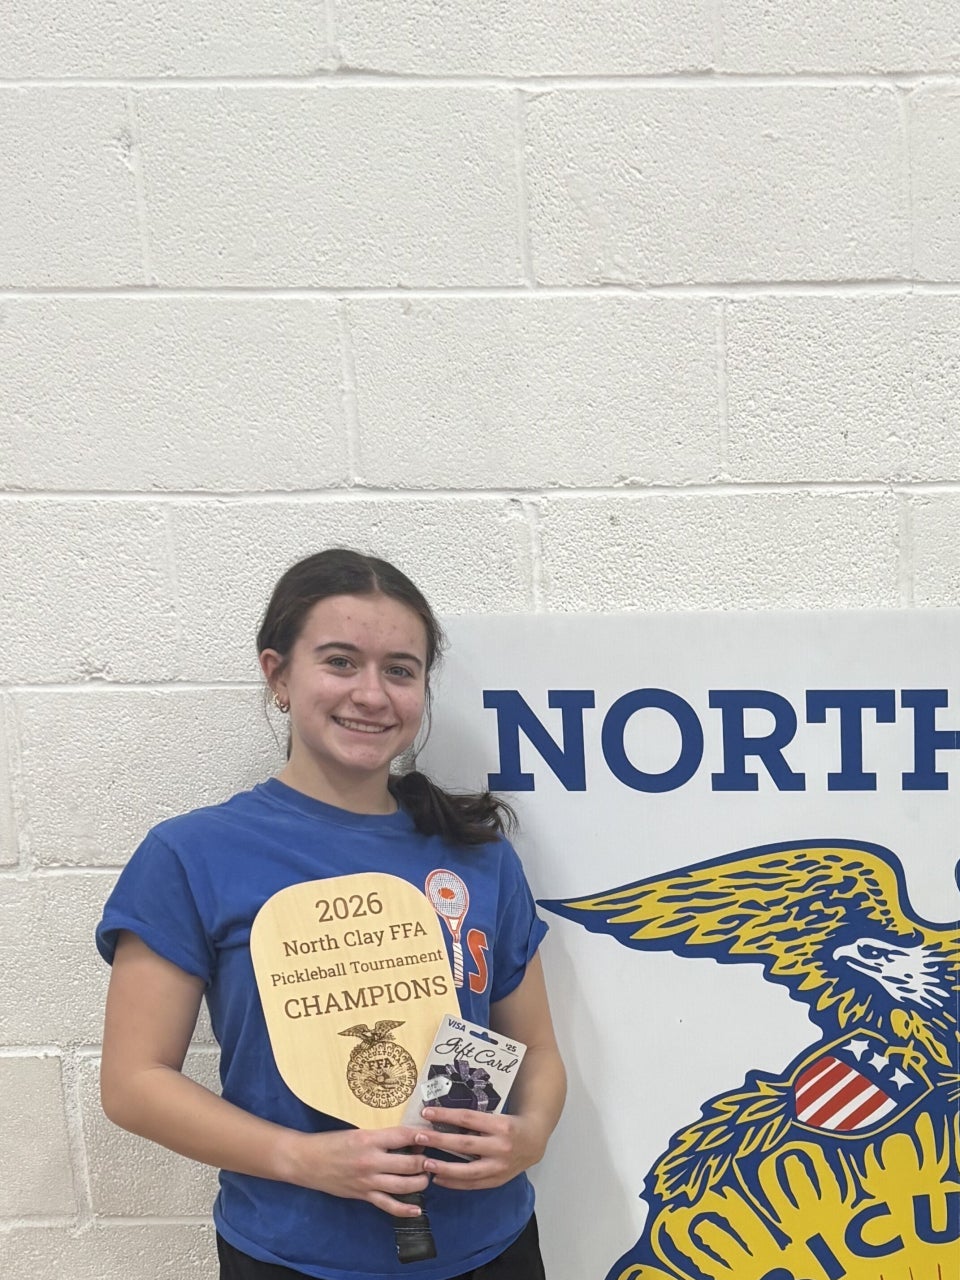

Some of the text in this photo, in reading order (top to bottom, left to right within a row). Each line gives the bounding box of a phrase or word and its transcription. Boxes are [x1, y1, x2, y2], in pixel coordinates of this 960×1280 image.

[315, 892, 383, 923] 2026
[283, 921, 428, 957] North Clay FFA
[271, 949, 443, 986] Pickleball Tournament
[284, 975, 448, 1019] CHAMPIONS
[448, 1018, 466, 1032] VISA
[367, 1057, 395, 1071] FFA
[434, 1037, 476, 1061] Gift
[474, 1049, 519, 1074] Card
[505, 1042, 517, 1053] $25
